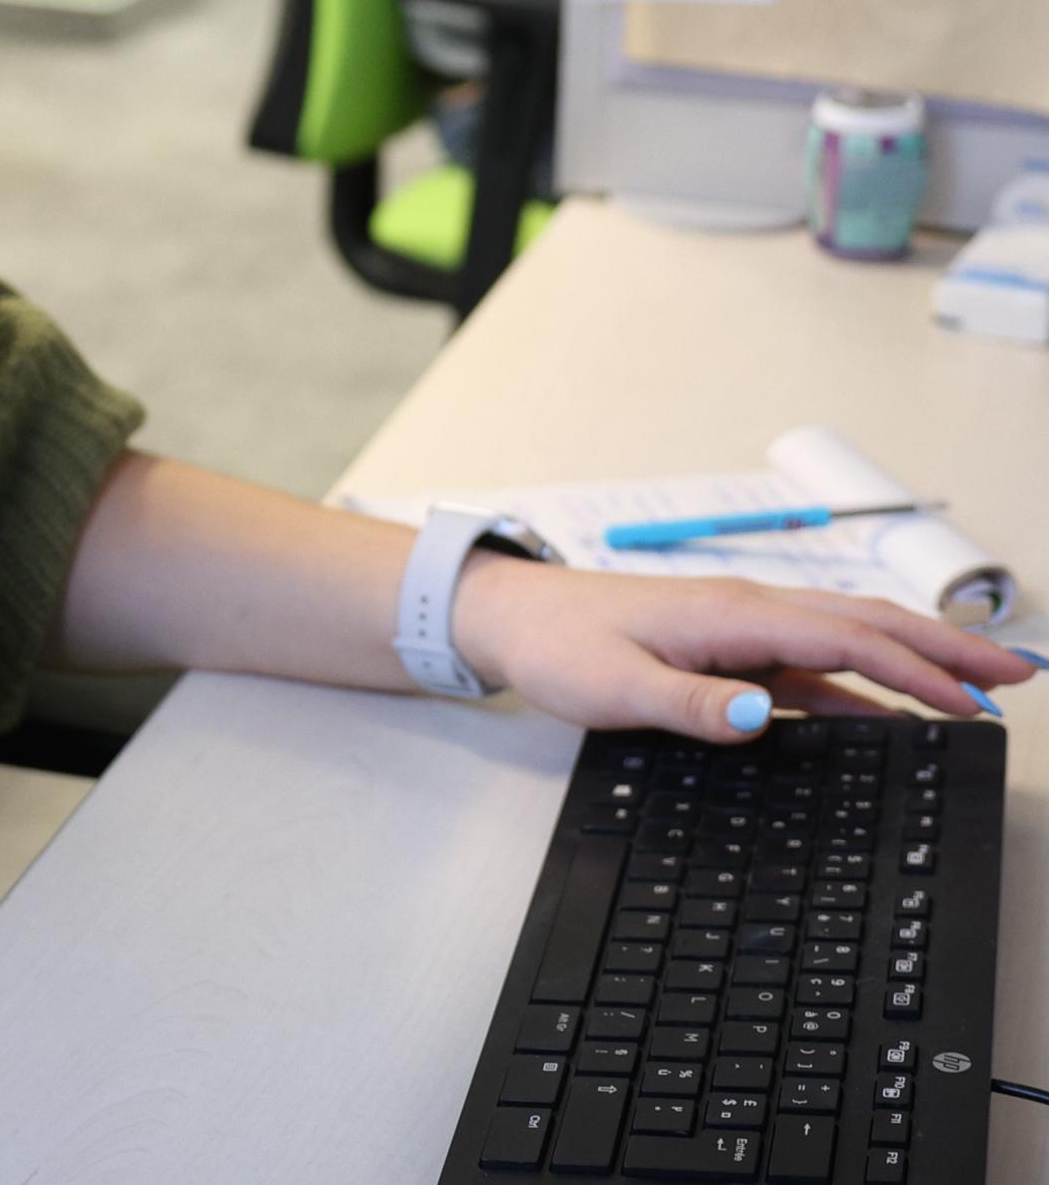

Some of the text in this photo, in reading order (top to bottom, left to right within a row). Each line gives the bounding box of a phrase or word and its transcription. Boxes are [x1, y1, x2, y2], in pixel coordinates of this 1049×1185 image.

[776, 896, 791, 906] Y
[839, 915, 854, 923] 7
[705, 932, 720, 940] J
[769, 927, 785, 936] U
[835, 945, 851, 954] 8
[907, 952, 918, 961] F7
[698, 964, 714, 972] K
[830, 978, 846, 987] 9
[904, 984, 915, 994] F8
[690, 996, 707, 1004] L
[752, 1025, 768, 1034] P
[683, 1033, 699, 1043] M
[899, 1041, 910, 1051] F9
[932, 1052, 972, 1073] hp
[894, 1076, 906, 1089] F10
[890, 1113, 902, 1124] F11
[886, 1151, 898, 1164] F12
